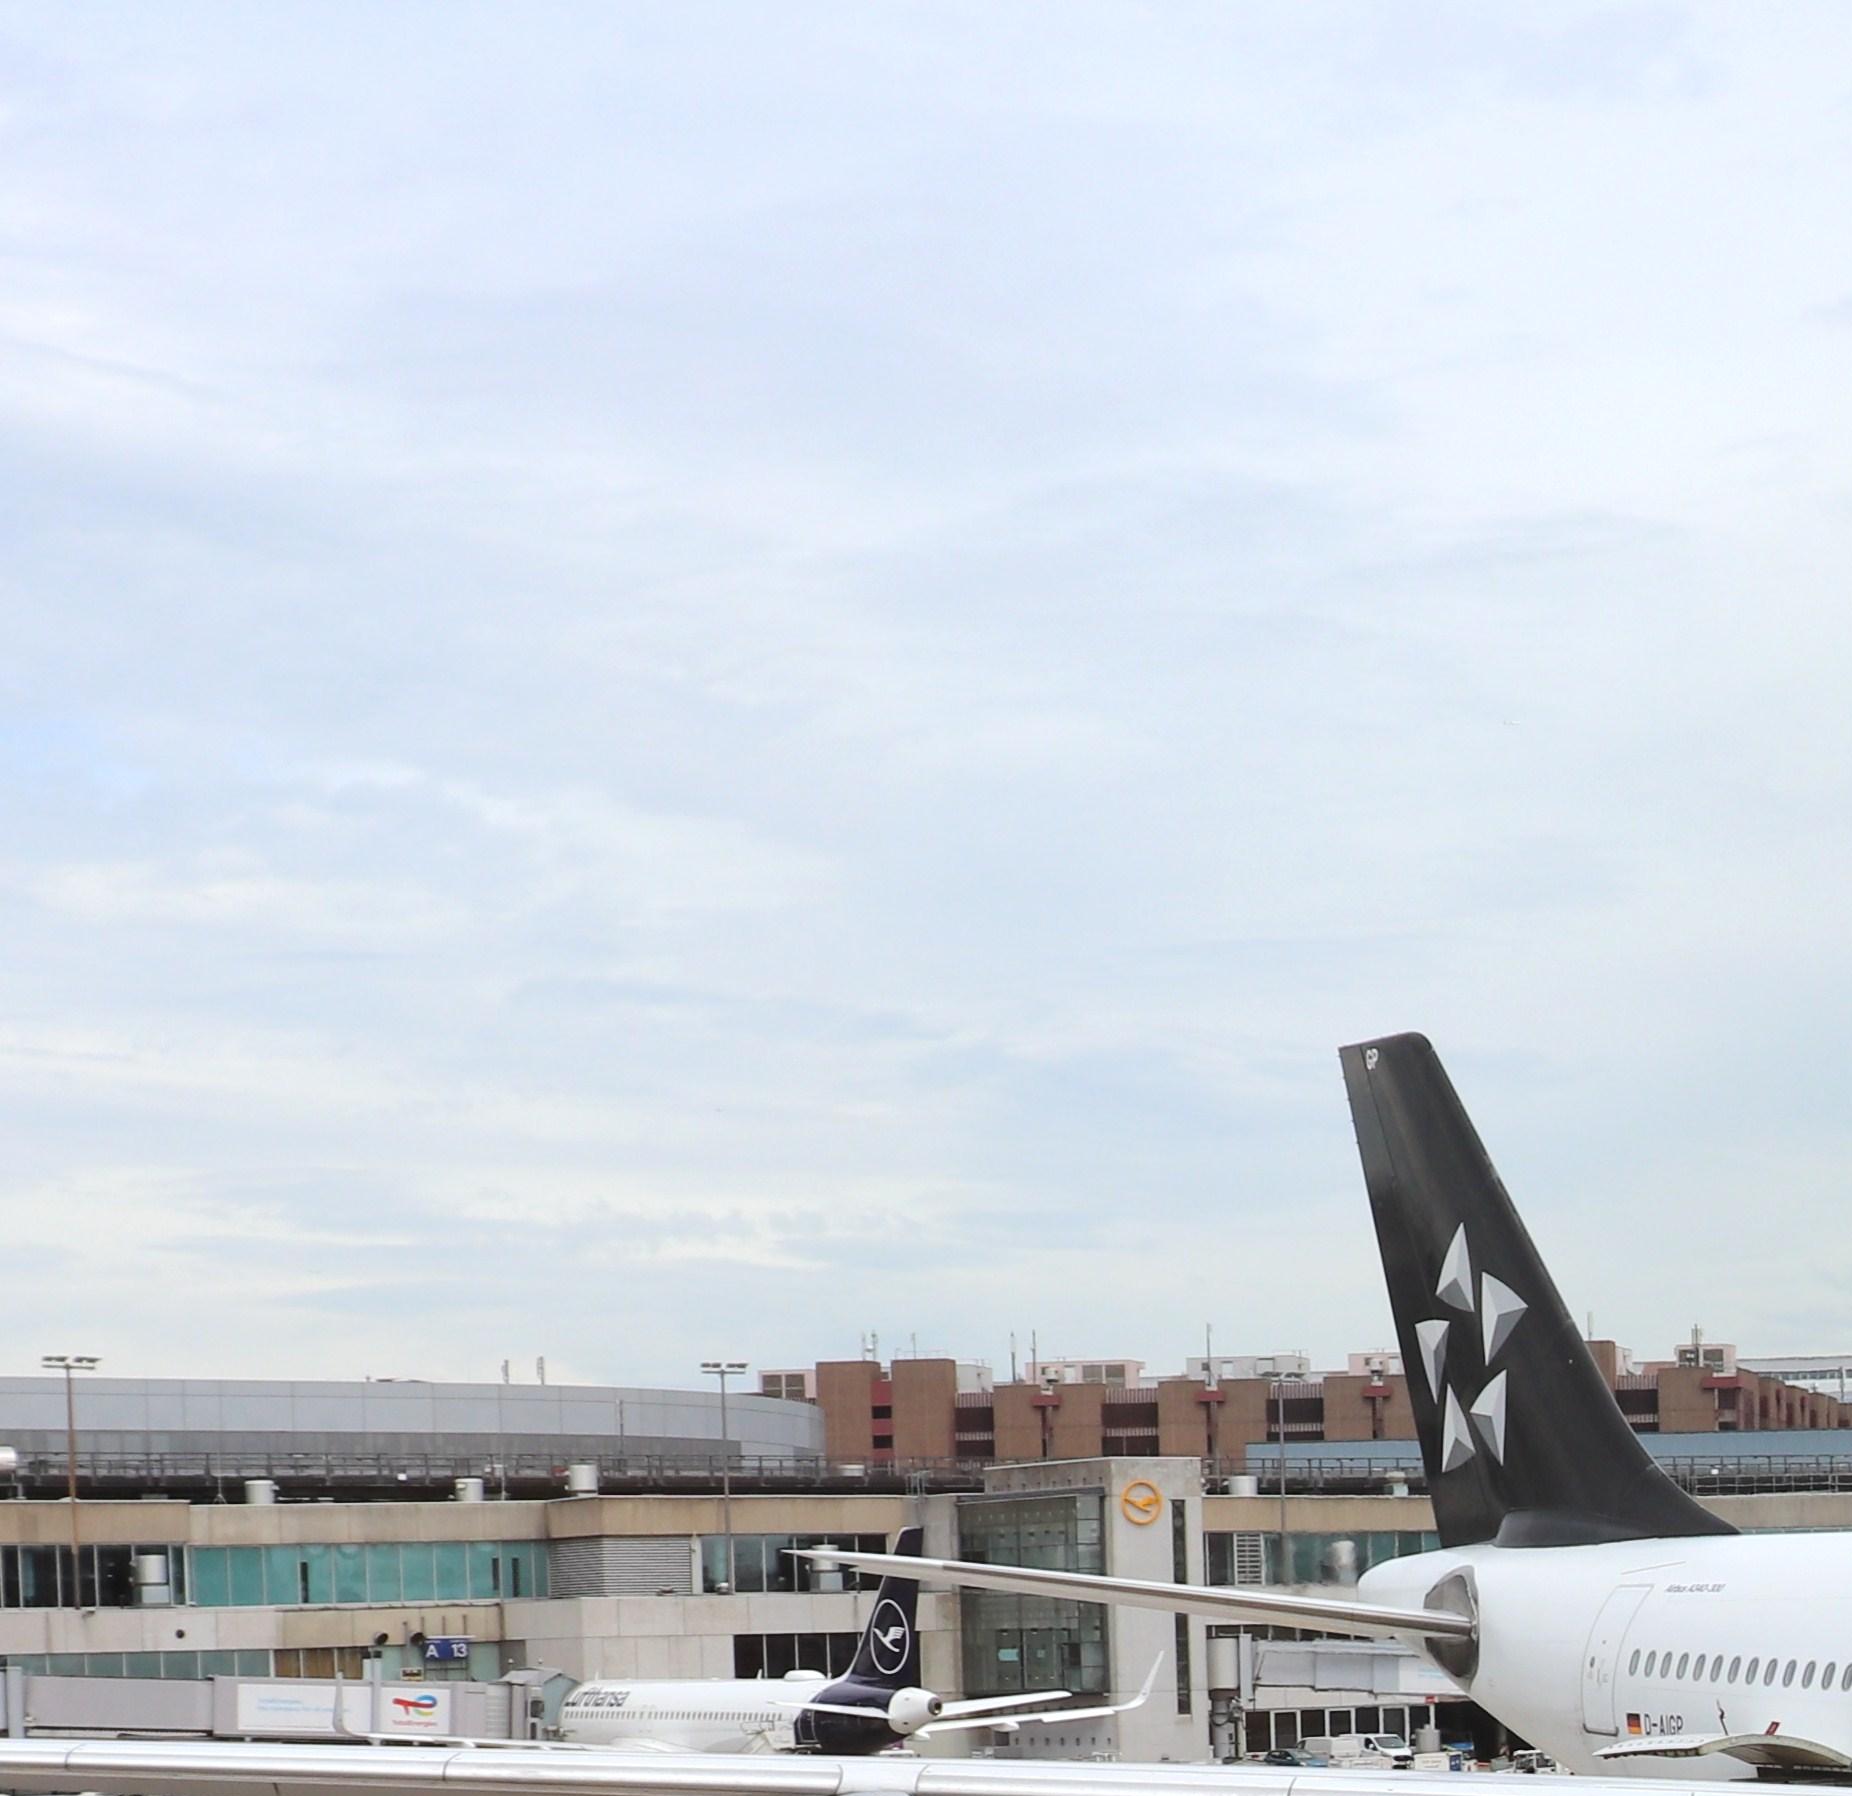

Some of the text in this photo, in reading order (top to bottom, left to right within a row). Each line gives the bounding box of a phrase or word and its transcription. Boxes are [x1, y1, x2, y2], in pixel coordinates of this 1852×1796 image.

[425, 1643, 468, 1658] A 13
[1643, 1713, 1684, 1736] D-AIGP
